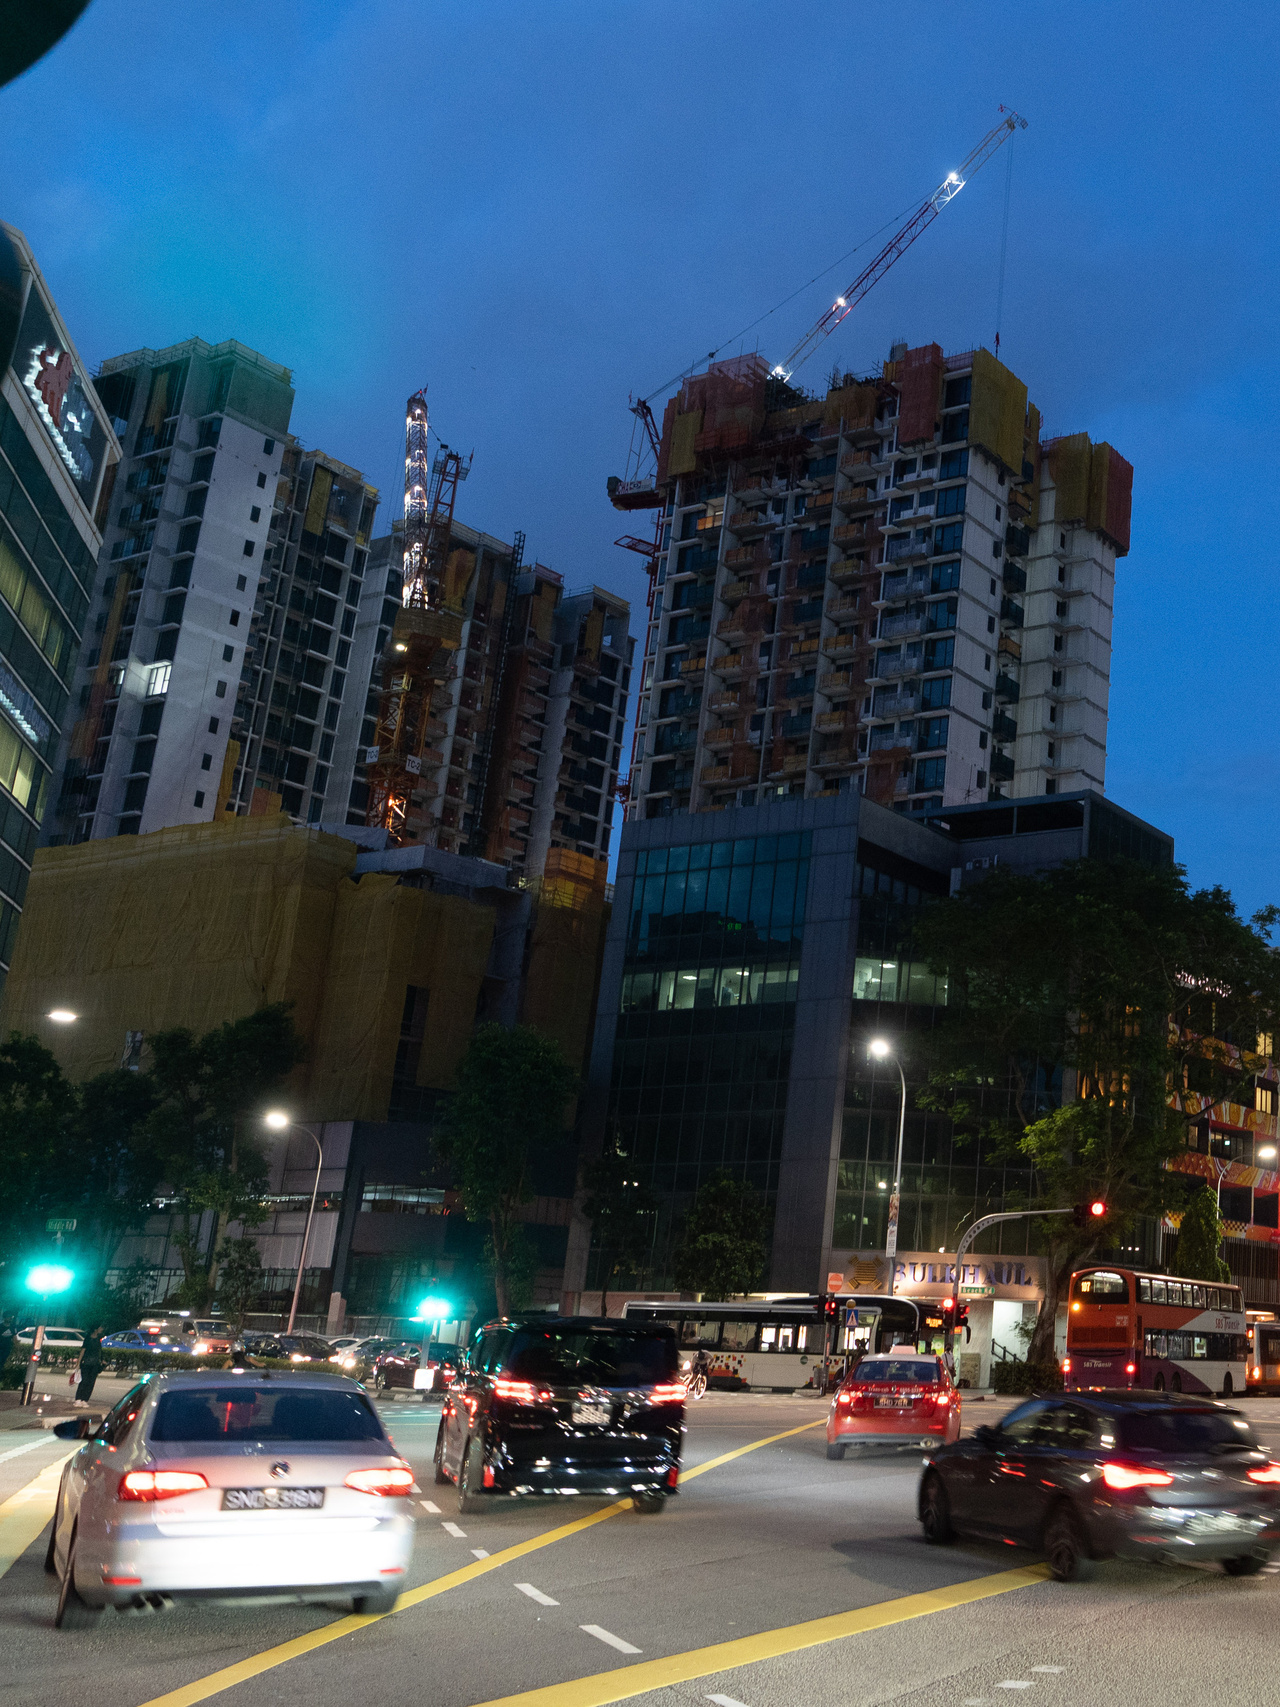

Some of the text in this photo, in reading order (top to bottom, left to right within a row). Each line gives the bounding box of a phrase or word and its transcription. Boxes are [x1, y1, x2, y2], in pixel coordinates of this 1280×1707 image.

[407, 758, 421, 771] TC-2
[65, 1221, 73, 1230] Rd
[893, 1261, 1034, 1287] BULKHAUL
[984, 1287, 992, 1295] Rd
[1081, 1281, 1091, 1293] 107
[1215, 1316, 1240, 1331] SBS Transit
[1093, 1360, 1112, 1368] Transit
